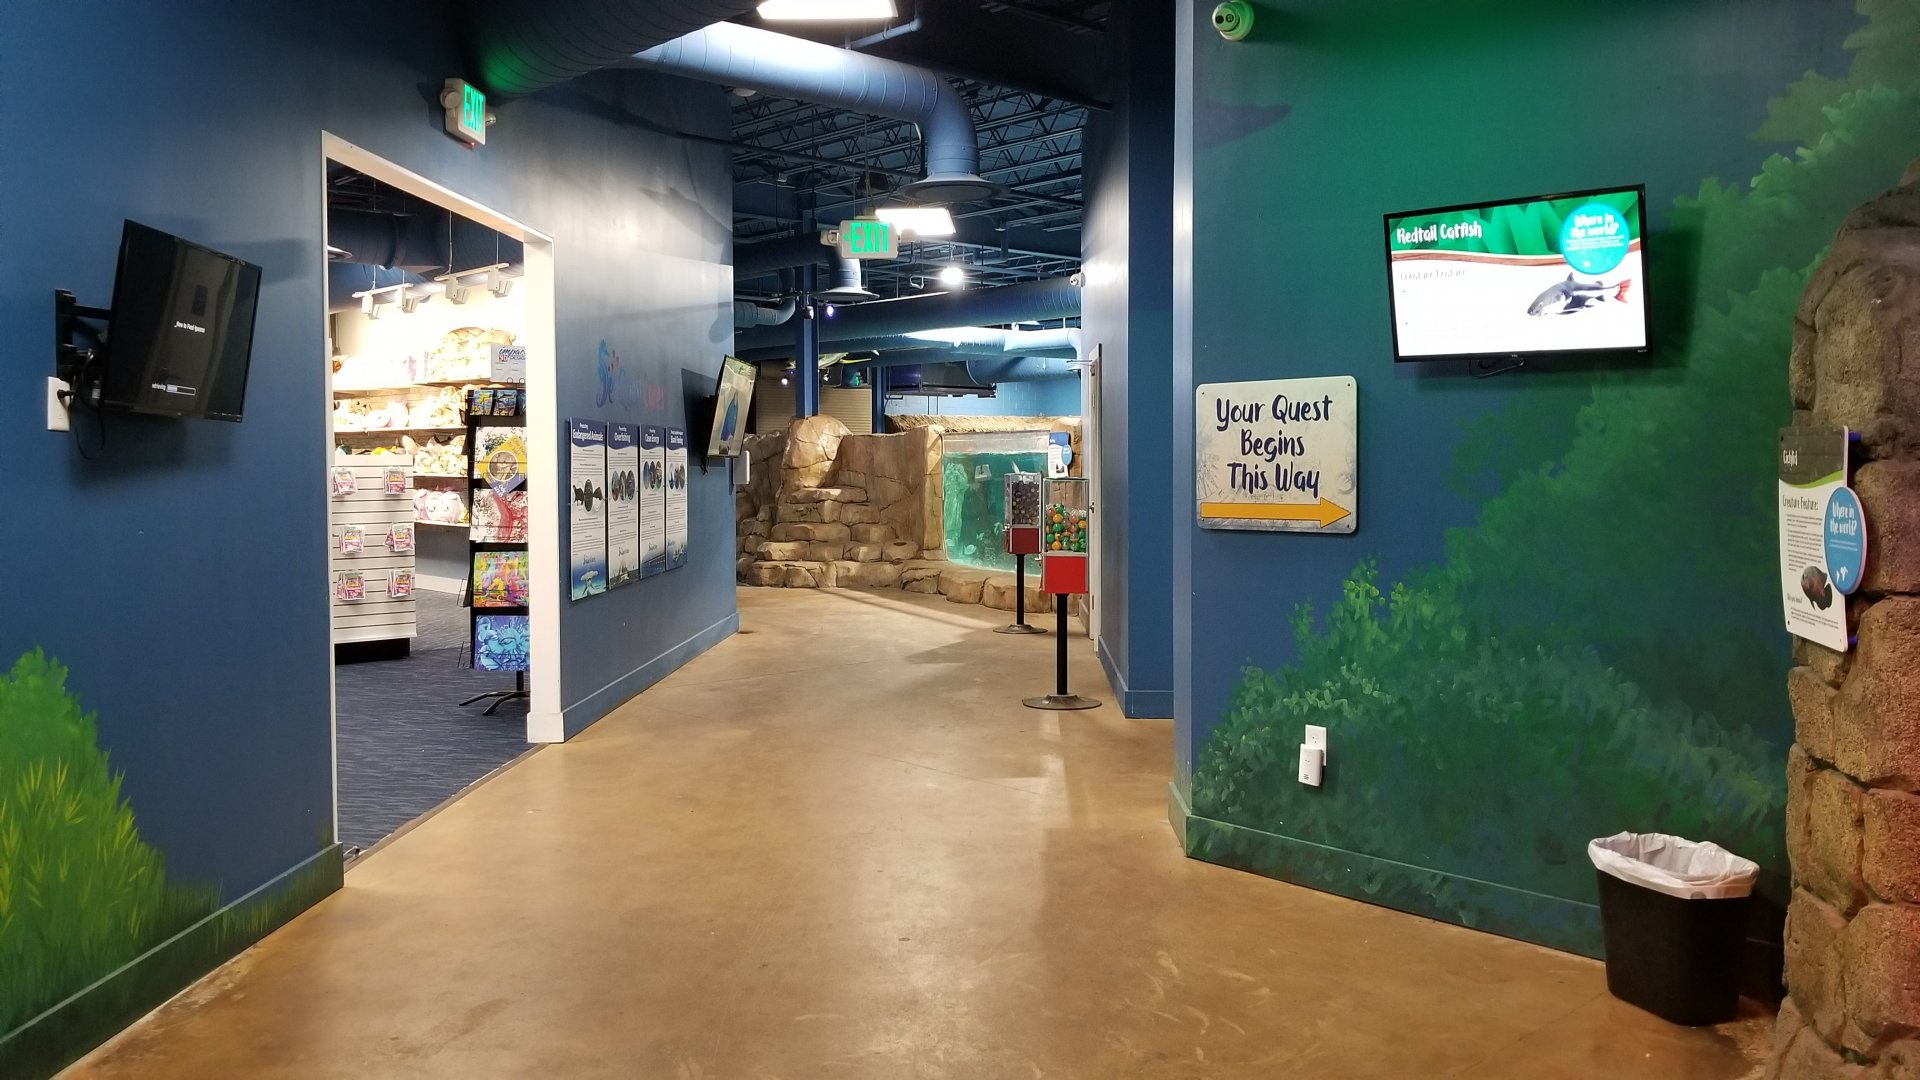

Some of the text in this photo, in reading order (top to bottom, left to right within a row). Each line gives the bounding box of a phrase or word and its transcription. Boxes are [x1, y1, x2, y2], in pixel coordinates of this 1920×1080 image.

[464, 84, 484, 133] EXIT
[851, 222, 889, 253] EXIT
[1397, 220, 1482, 244] Redtail Catfish
[1216, 394, 1333, 431] Your Quest
[1241, 429, 1305, 462] Begins
[1227, 461, 1319, 499] This Way
[1832, 501, 1855, 519] Where in
[1830, 518, 1858, 536] the world?
